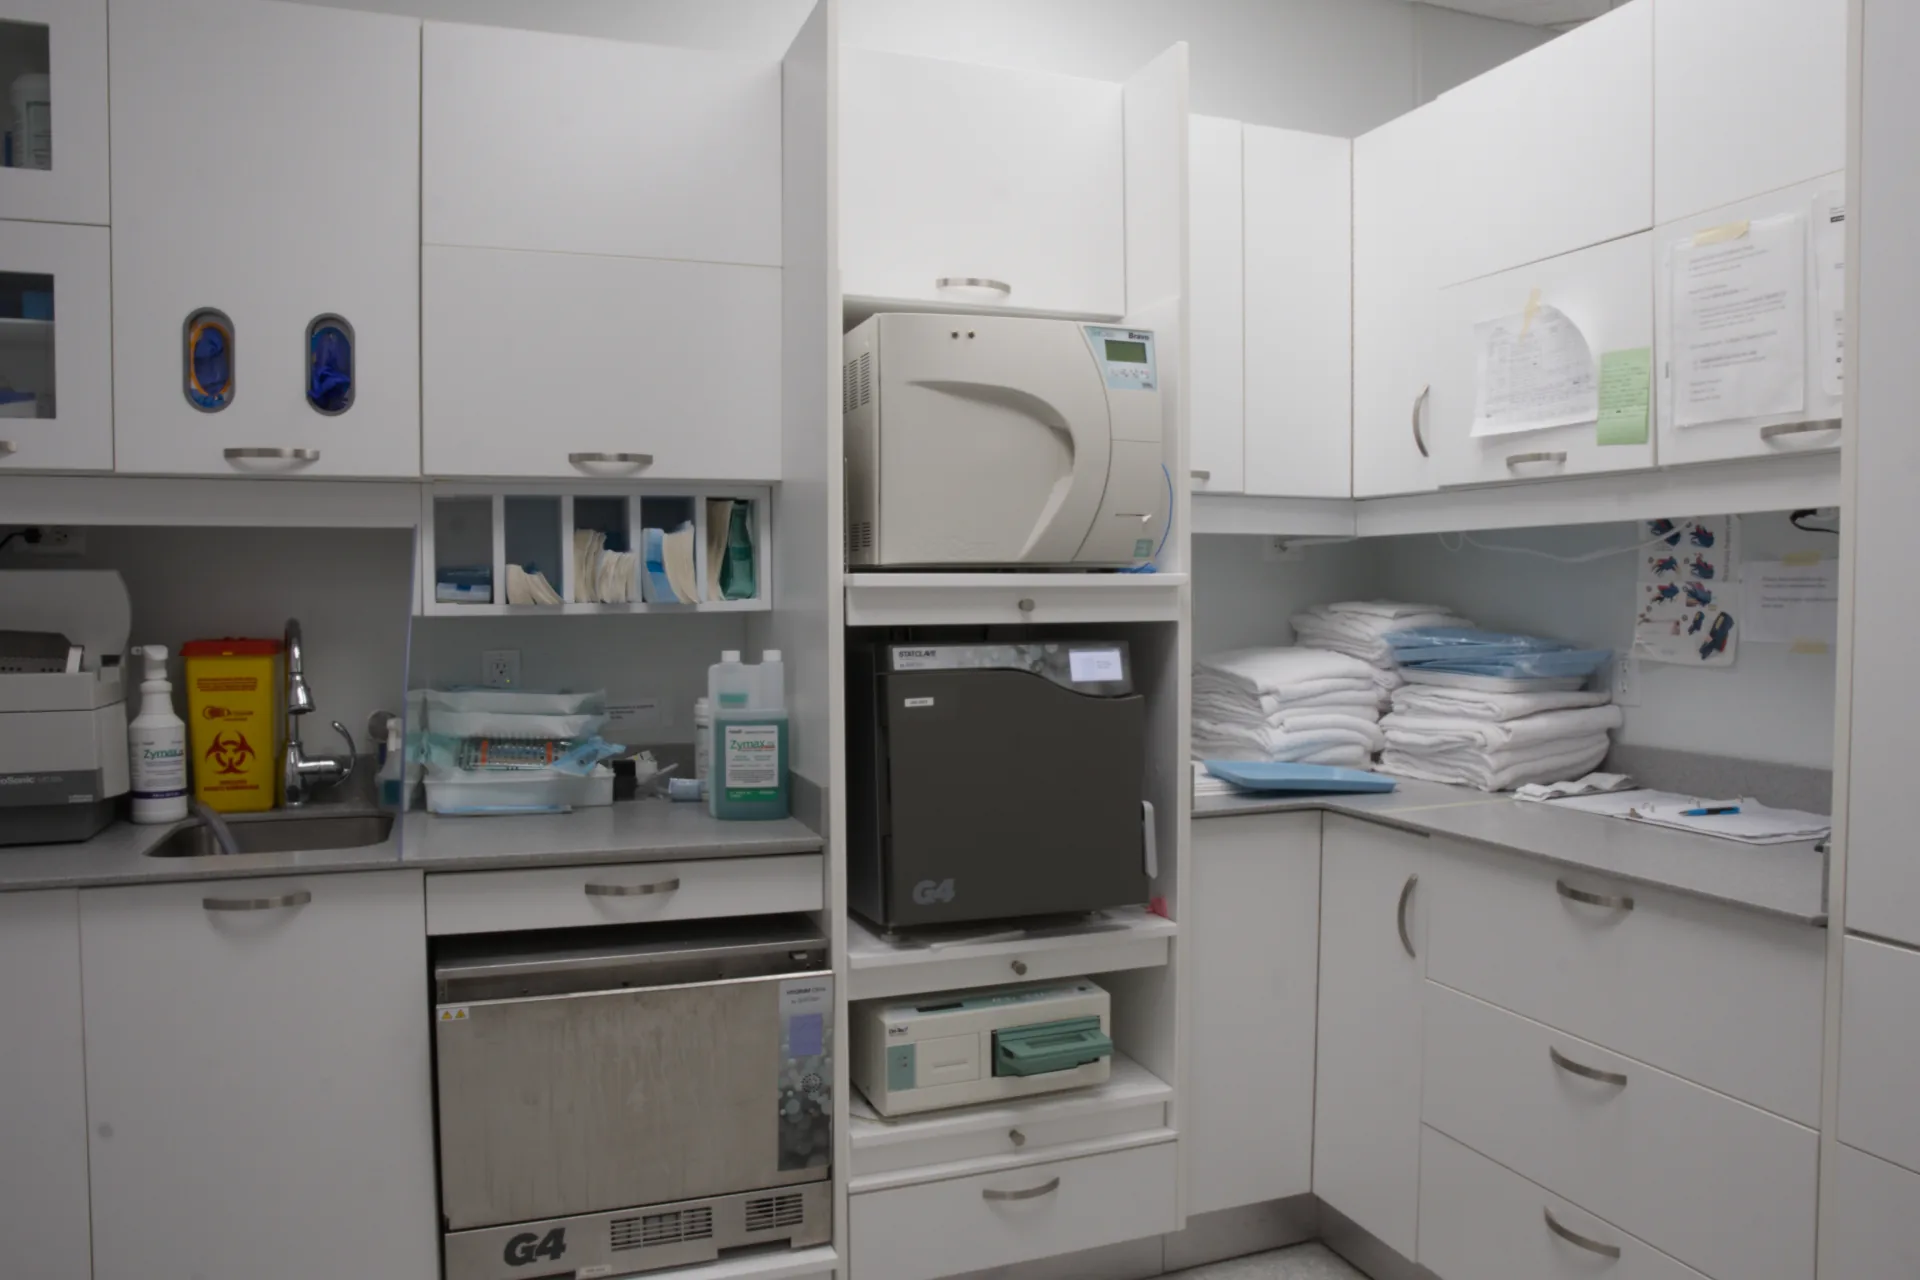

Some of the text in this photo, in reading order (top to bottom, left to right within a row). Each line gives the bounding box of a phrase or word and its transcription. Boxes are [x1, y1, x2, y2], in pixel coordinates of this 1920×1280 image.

[1128, 332, 1150, 341] Bravo
[729, 740, 765, 750] Zymax
[0, 776, 35, 785] oSonic
[912, 878, 956, 905] G4
[504, 1227, 567, 1266] G4
